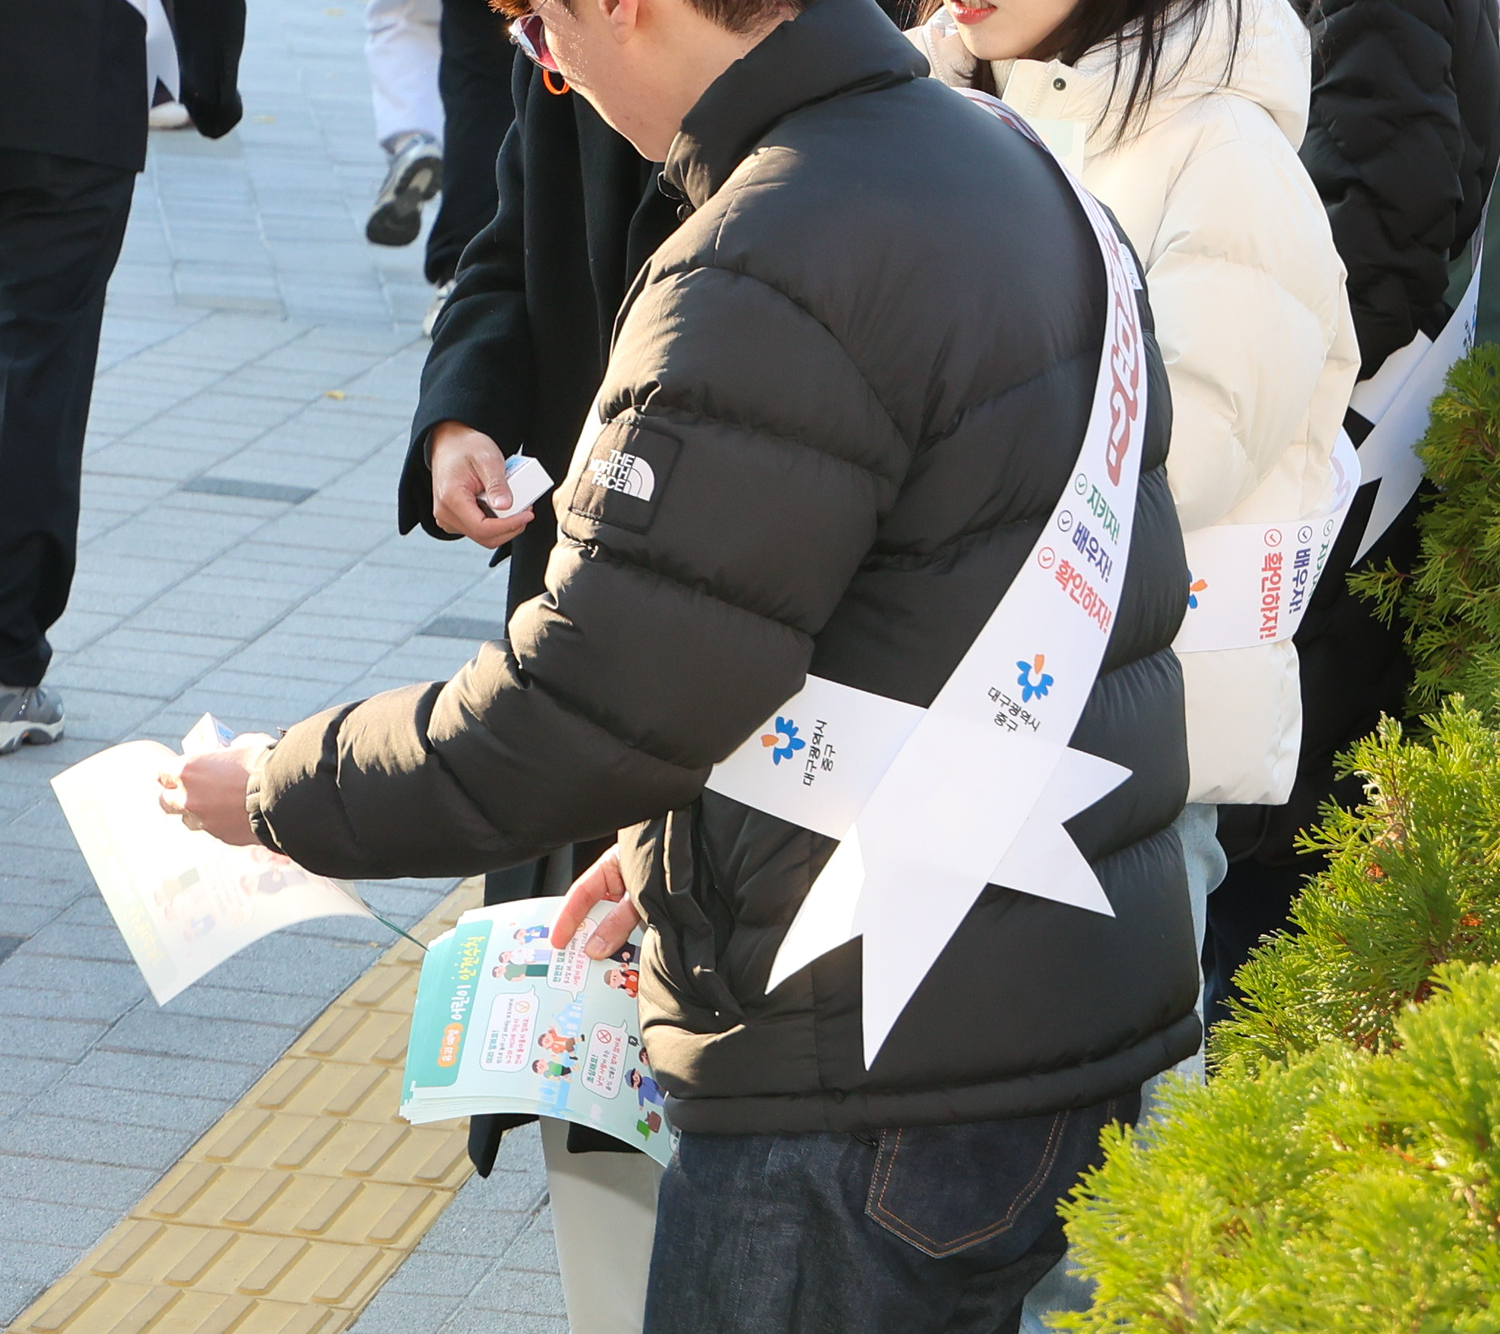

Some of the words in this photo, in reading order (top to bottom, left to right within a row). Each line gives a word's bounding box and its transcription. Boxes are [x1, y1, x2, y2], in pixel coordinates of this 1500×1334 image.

[589, 458, 631, 481] NORTH
[609, 449, 636, 468] THE
[592, 473, 627, 494] FACE
[1086, 483, 1121, 546] 지키자!
[1073, 523, 1114, 585] 배우자!
[1055, 557, 1112, 635] 확인하자!
[1260, 551, 1283, 641] 확인하자!
[1288, 547, 1312, 616] 배우자!
[987, 686, 1041, 732] 대구광역시
[993, 710, 1019, 733] 중구
[803, 719, 828, 787] 대구광역시
[821, 744, 837, 772] 중구
[457, 936, 486, 982] 안전수칙
[451, 984, 471, 1021] 어린이
